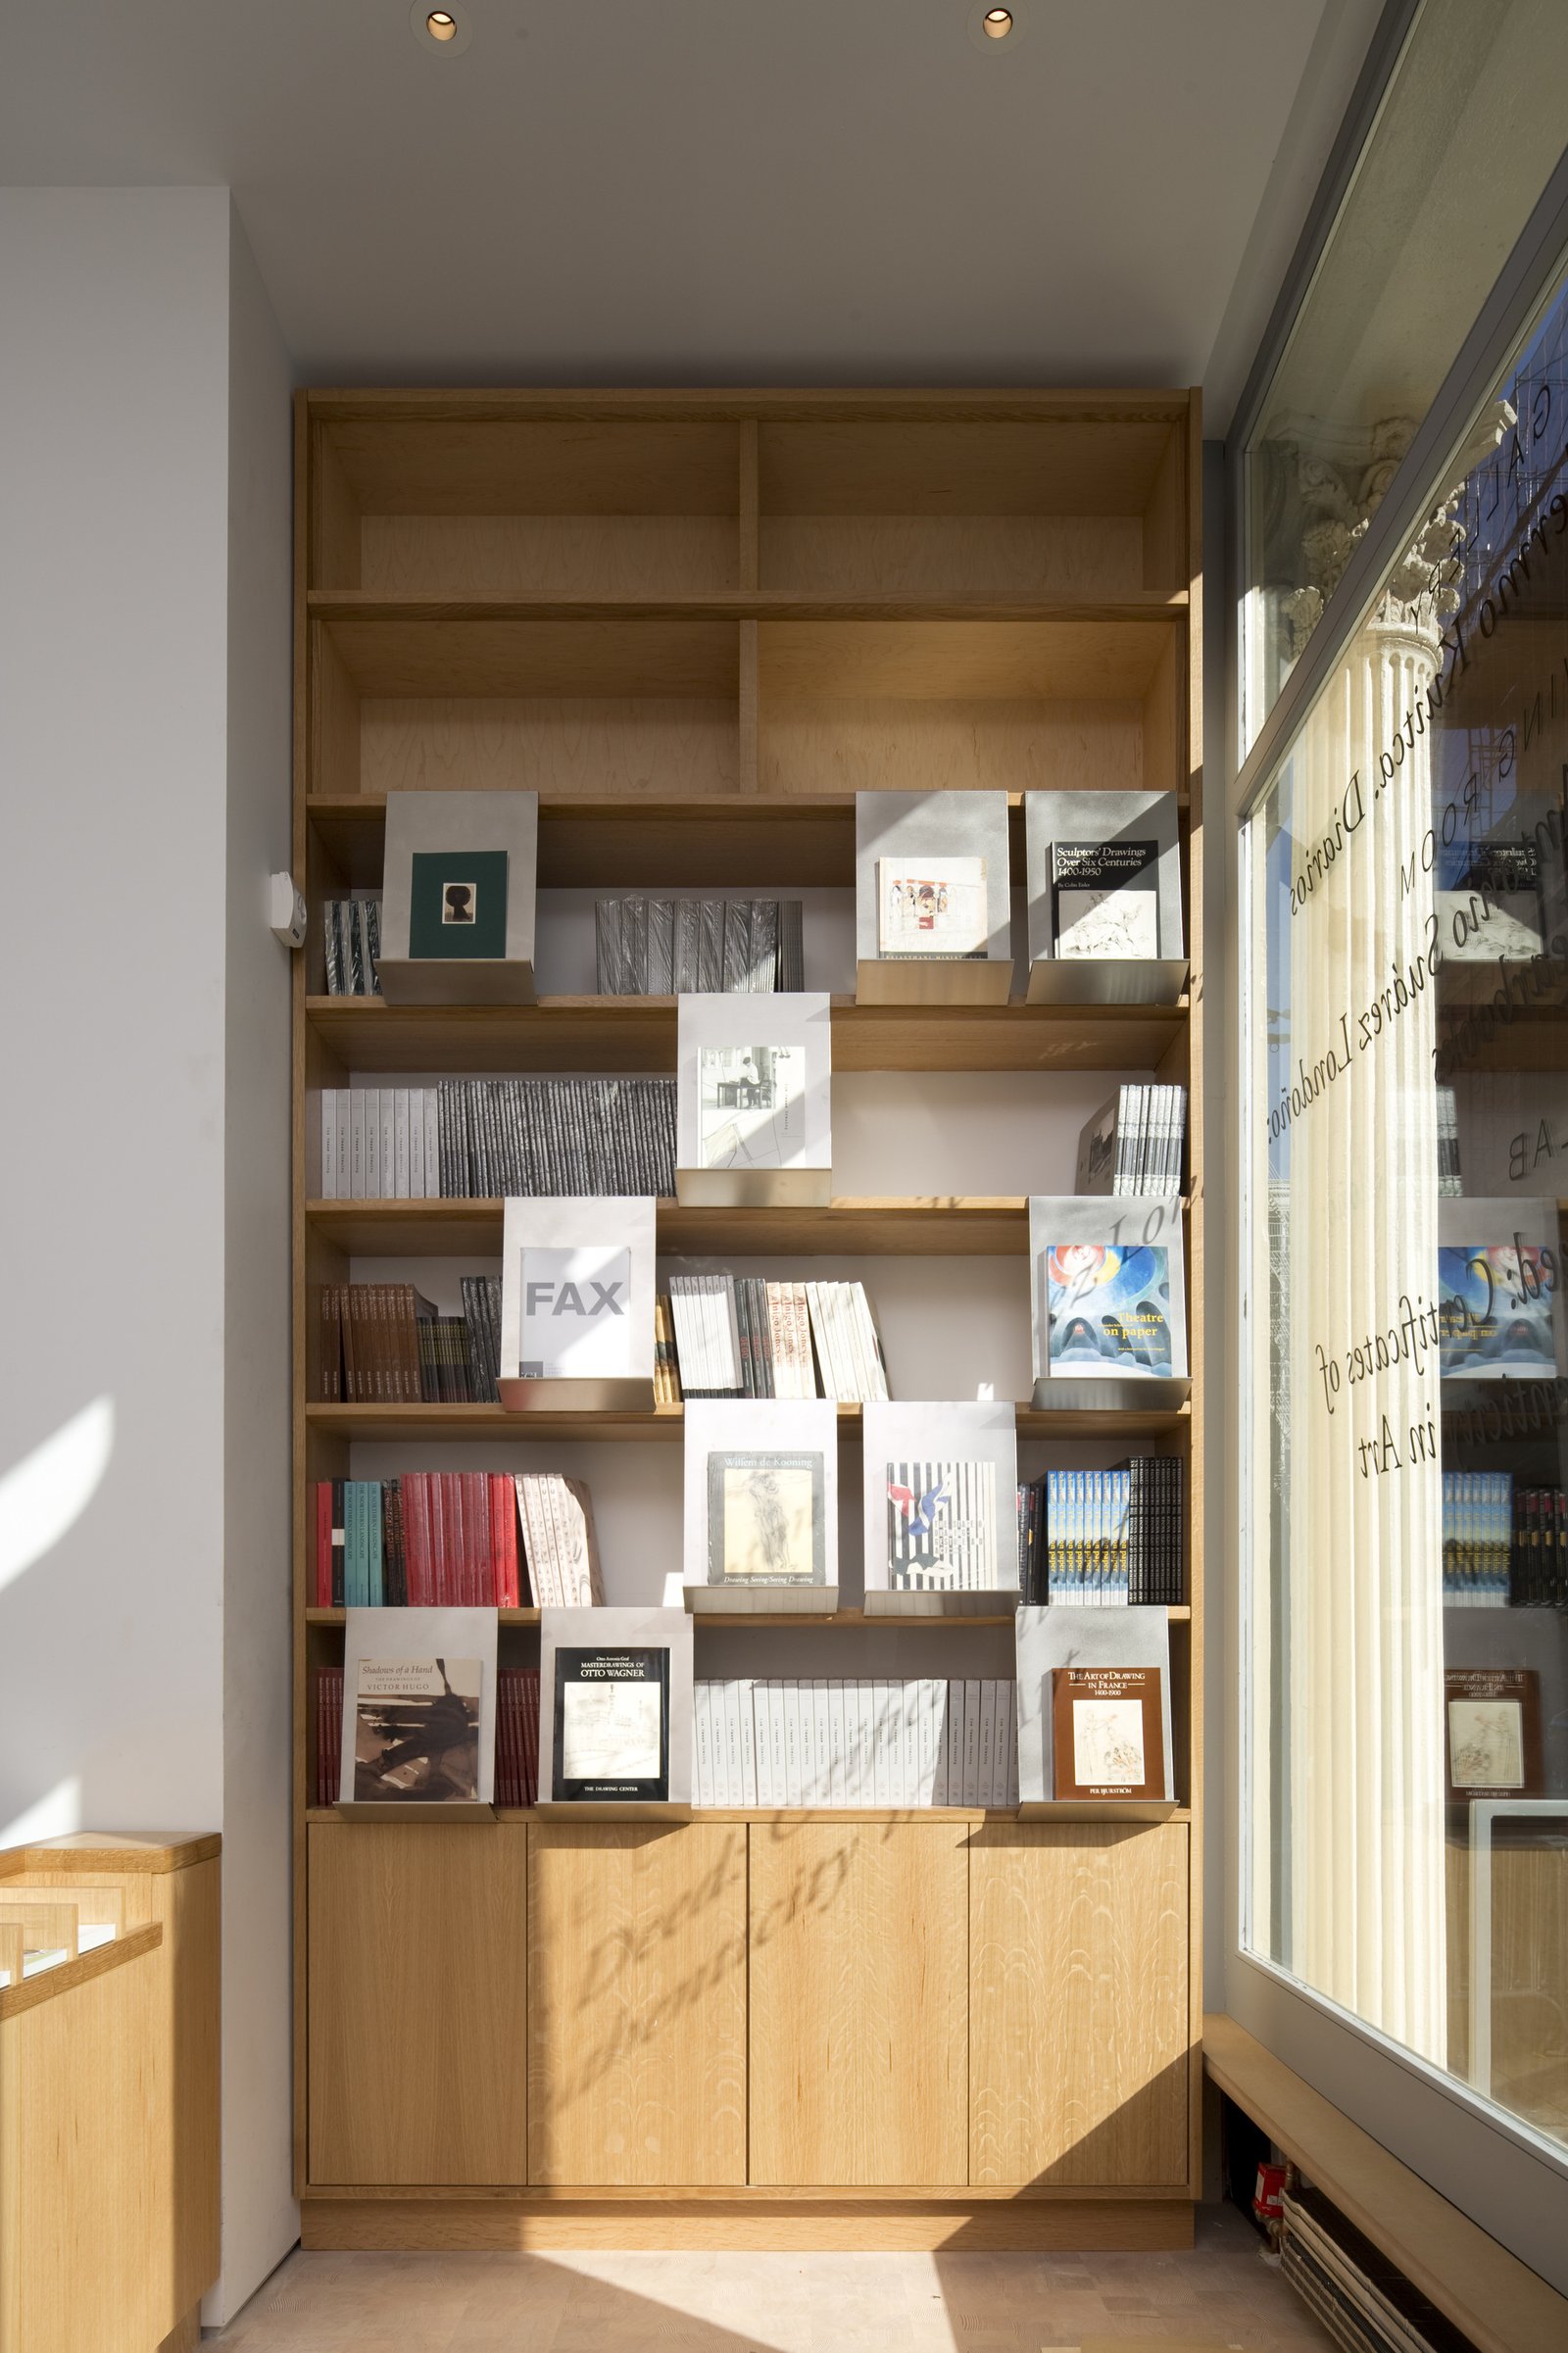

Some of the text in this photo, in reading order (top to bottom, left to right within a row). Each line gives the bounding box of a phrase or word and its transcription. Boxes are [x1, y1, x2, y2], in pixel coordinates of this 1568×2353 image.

[1056, 847, 1147, 858] Sculptors' Drawings
[1056, 858, 1142, 866] Over Six Centuries
[1057, 867, 1102, 876] 1400-1950
[526, 1282, 624, 1316] FAX
[1118, 1312, 1164, 1323] Theatre
[1122, 1328, 1157, 1340] paper
[723, 1457, 758, 1467] Willem
[774, 1457, 813, 1468] Kooning
[362, 1665, 394, 1674] Shadows
[395, 1665, 404, 1675] of
[1109, 1671, 1146, 1680] DRAWING
